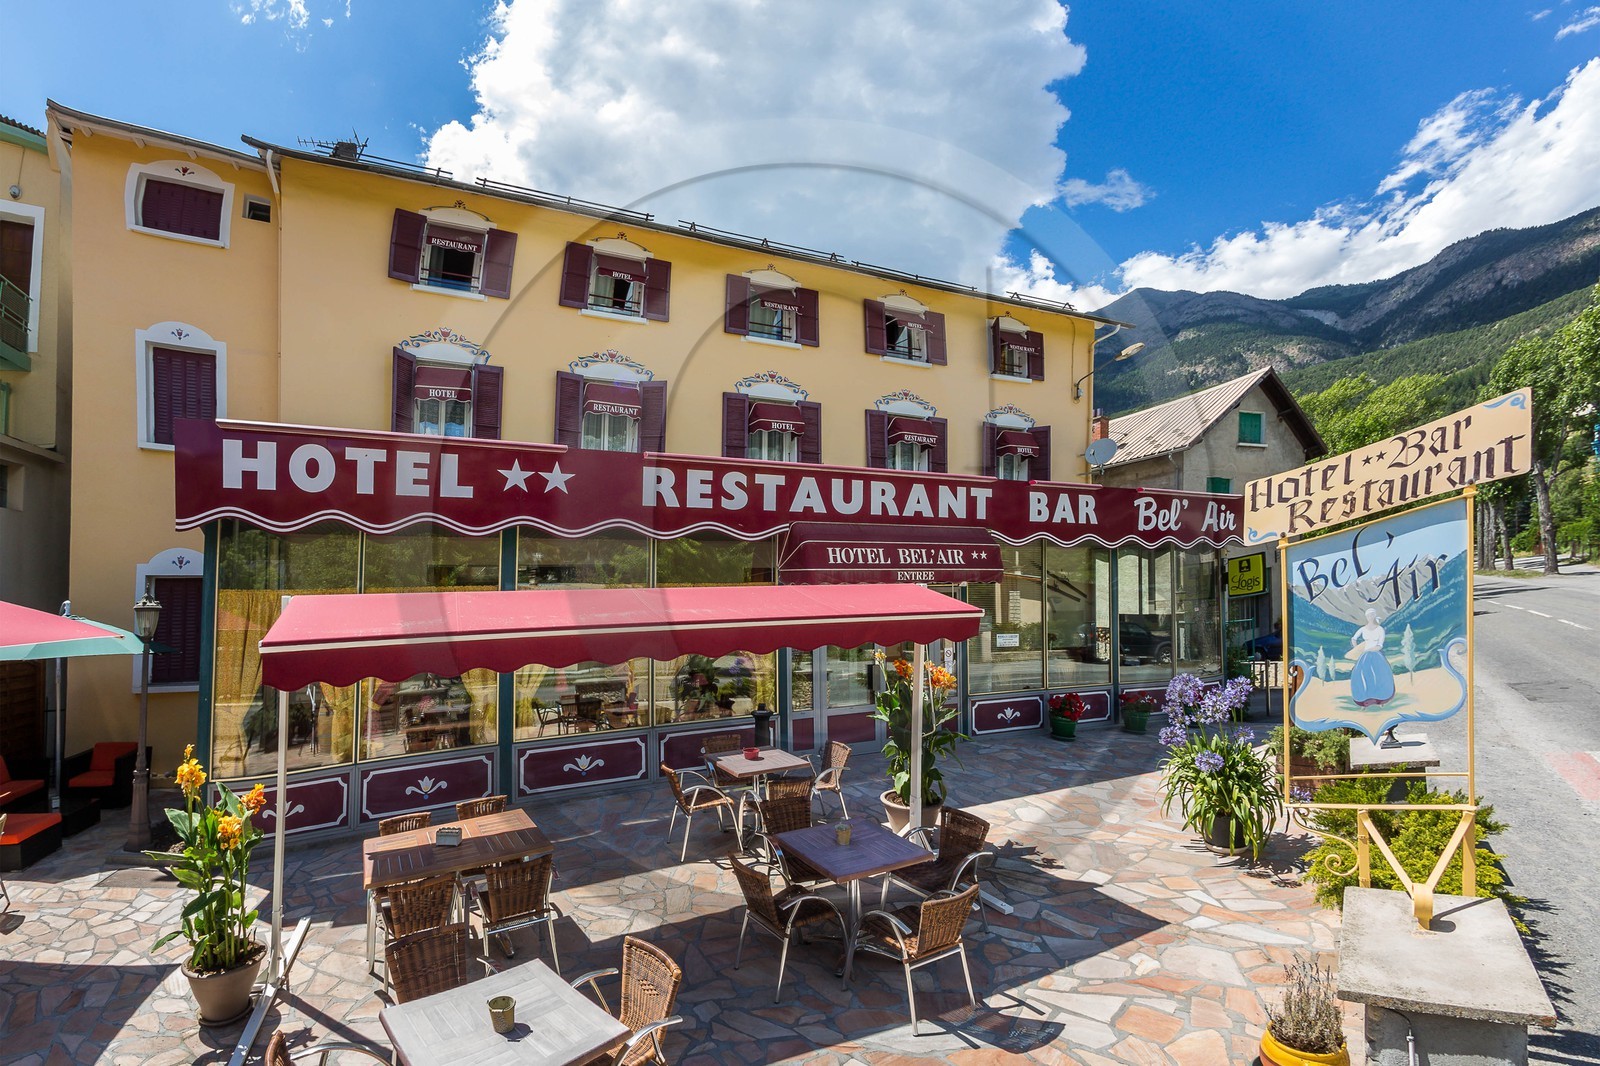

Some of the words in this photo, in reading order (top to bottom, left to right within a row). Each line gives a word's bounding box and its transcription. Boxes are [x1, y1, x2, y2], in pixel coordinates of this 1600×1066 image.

[431, 237, 478, 251] RESTAURANT
[612, 271, 633, 281] HOTEL
[764, 301, 799, 312] RESTAURANT
[907, 321, 924, 330] HOTEL
[429, 389, 457, 399] HOTEL
[593, 403, 638, 416] RESTAURANT
[771, 422, 795, 431] HOTEL
[904, 434, 937, 444] RESTAURANT
[1017, 446, 1034, 454] HOTEL
[1249, 454, 1353, 513] Hotel
[1387, 415, 1472, 468] Bar
[222, 439, 474, 498] HOTEL
[642, 466, 993, 520] RESTAURANT
[1029, 491, 1098, 525] BAR
[1201, 500, 1237, 533] Air
[1287, 434, 1526, 533] Restaurant
[827, 547, 891, 565] HOTEL
[898, 548, 966, 566] BEL'AIR
[897, 570, 935, 581] ENTREE
[1231, 573, 1260, 591] Logis
